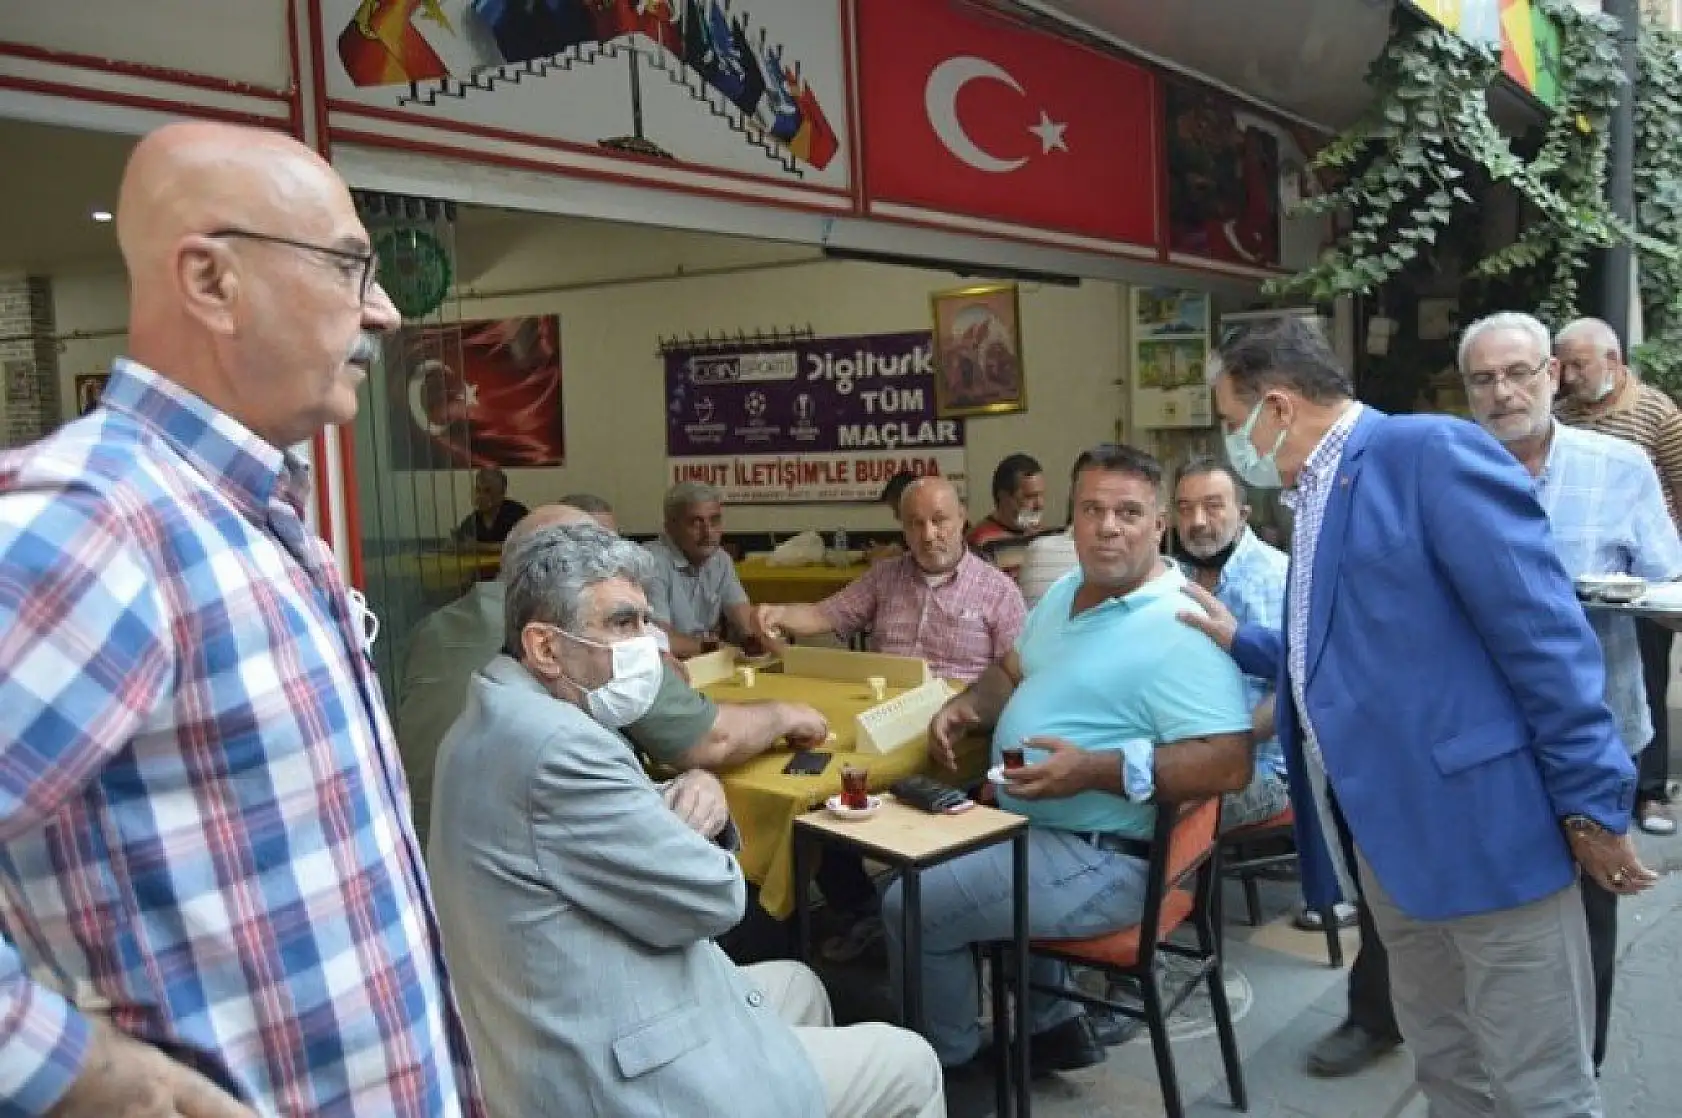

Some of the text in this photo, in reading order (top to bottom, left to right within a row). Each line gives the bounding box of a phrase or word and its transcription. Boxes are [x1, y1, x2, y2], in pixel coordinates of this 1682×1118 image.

[860, 384, 924, 414] TÜM
[838, 420, 957, 449] MAÇLAR
[674, 463, 729, 486] UMUT
[855, 457, 940, 482] BURADA
